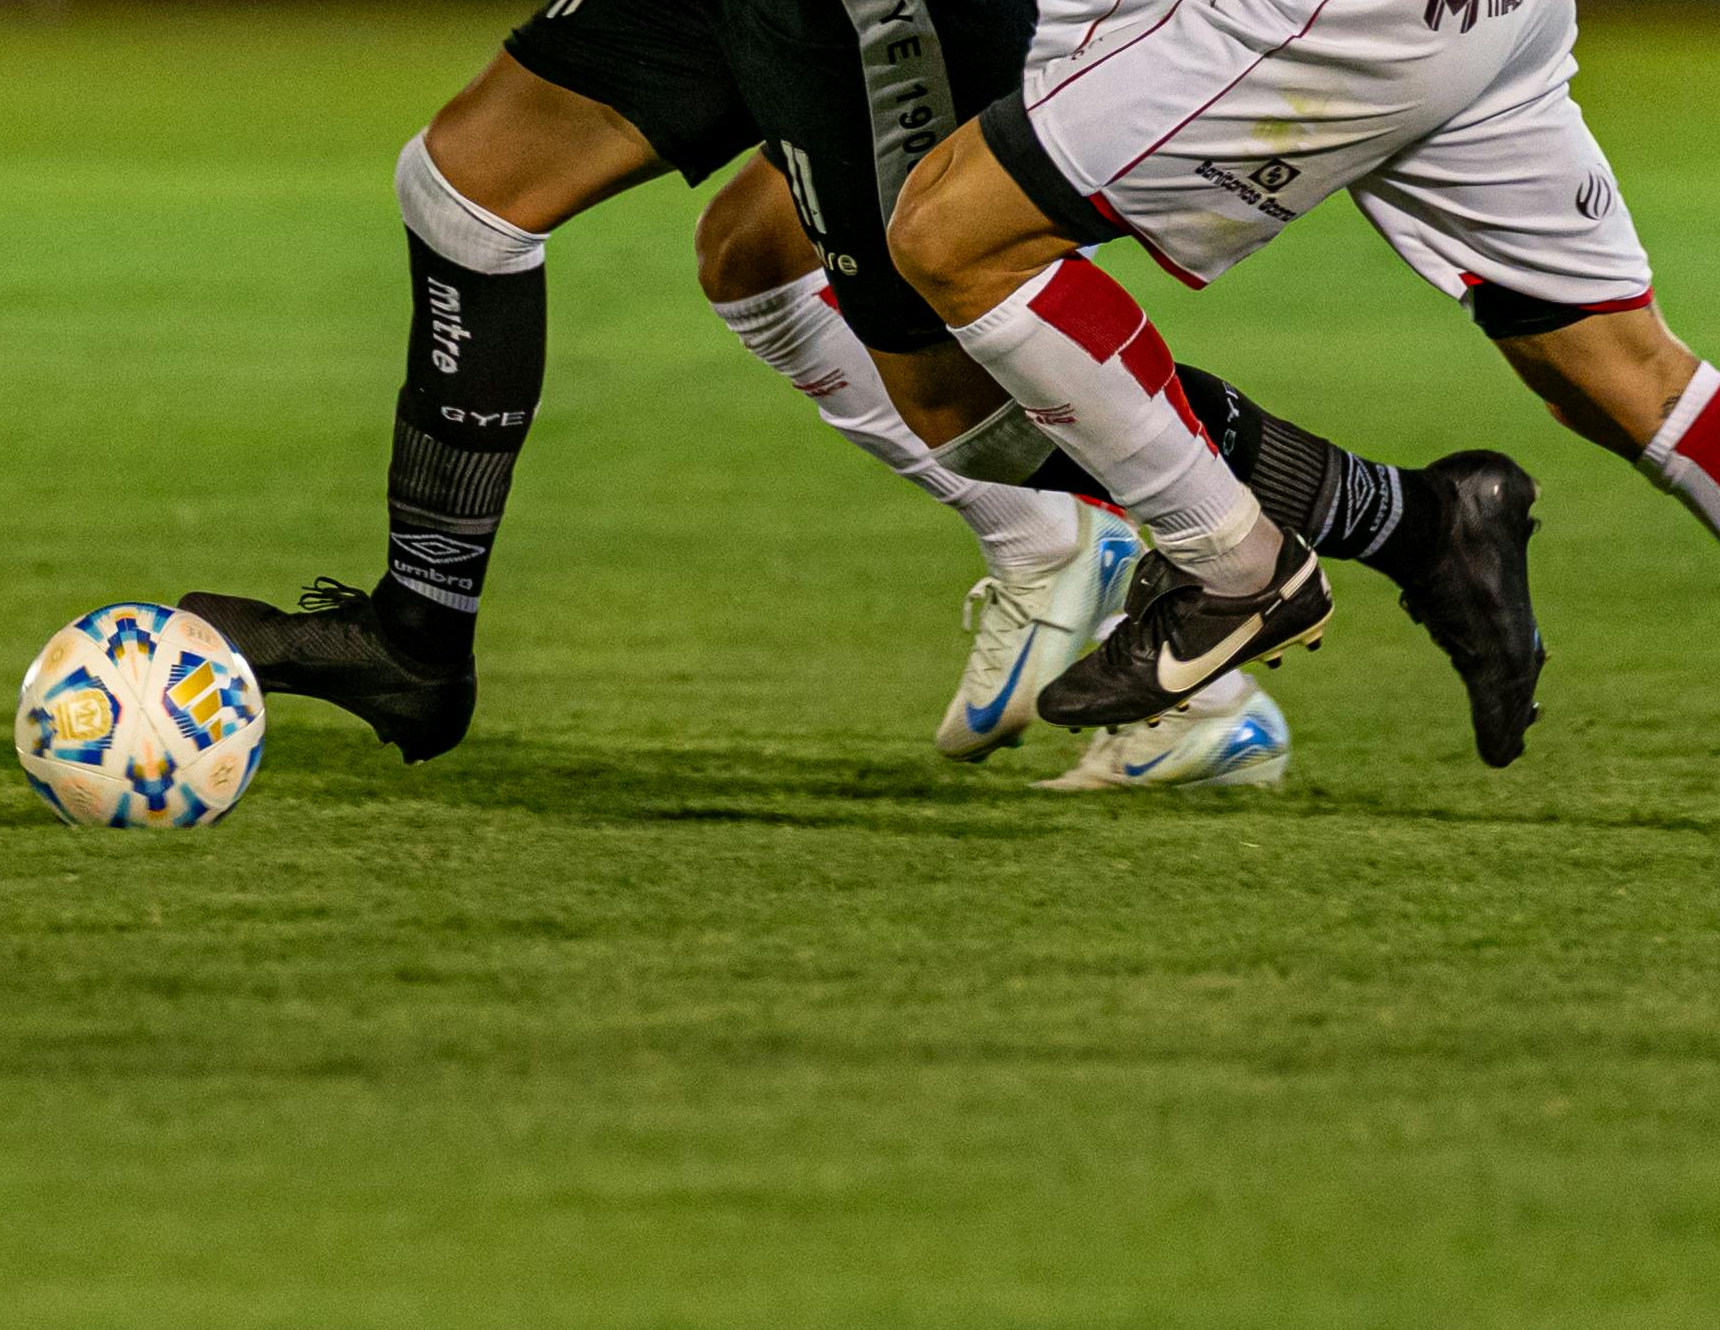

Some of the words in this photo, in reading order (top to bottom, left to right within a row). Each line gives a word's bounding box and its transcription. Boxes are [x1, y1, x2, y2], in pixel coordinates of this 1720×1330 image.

[896, 84, 937, 174] 190
[427, 276, 472, 374] mitre
[440, 406, 526, 427] GYE
[393, 558, 474, 591] umbro
